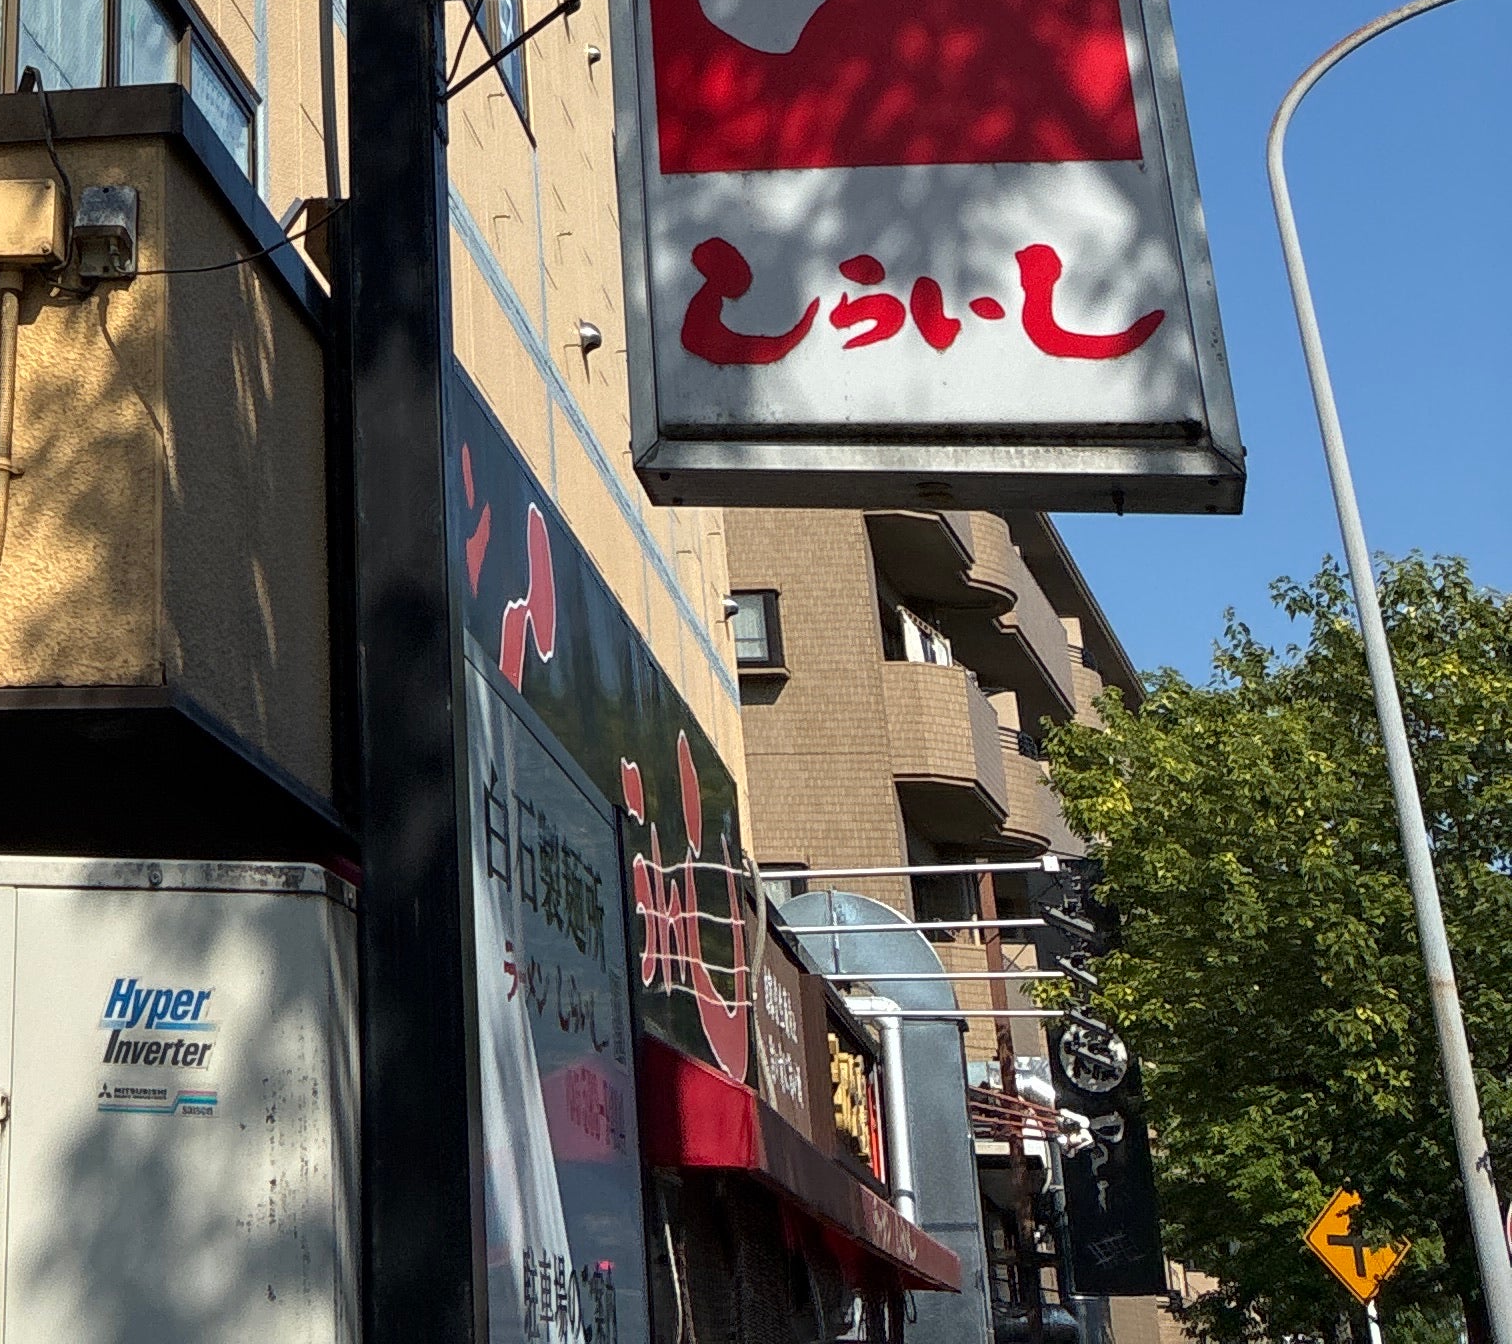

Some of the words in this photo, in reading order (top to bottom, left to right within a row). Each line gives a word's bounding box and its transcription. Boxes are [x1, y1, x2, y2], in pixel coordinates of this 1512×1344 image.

[681, 237, 1165, 365] しらいし
[483, 759, 607, 974] 白石製麺所
[103, 1029, 213, 1067] Inverter
[104, 978, 212, 1029] Hyper
